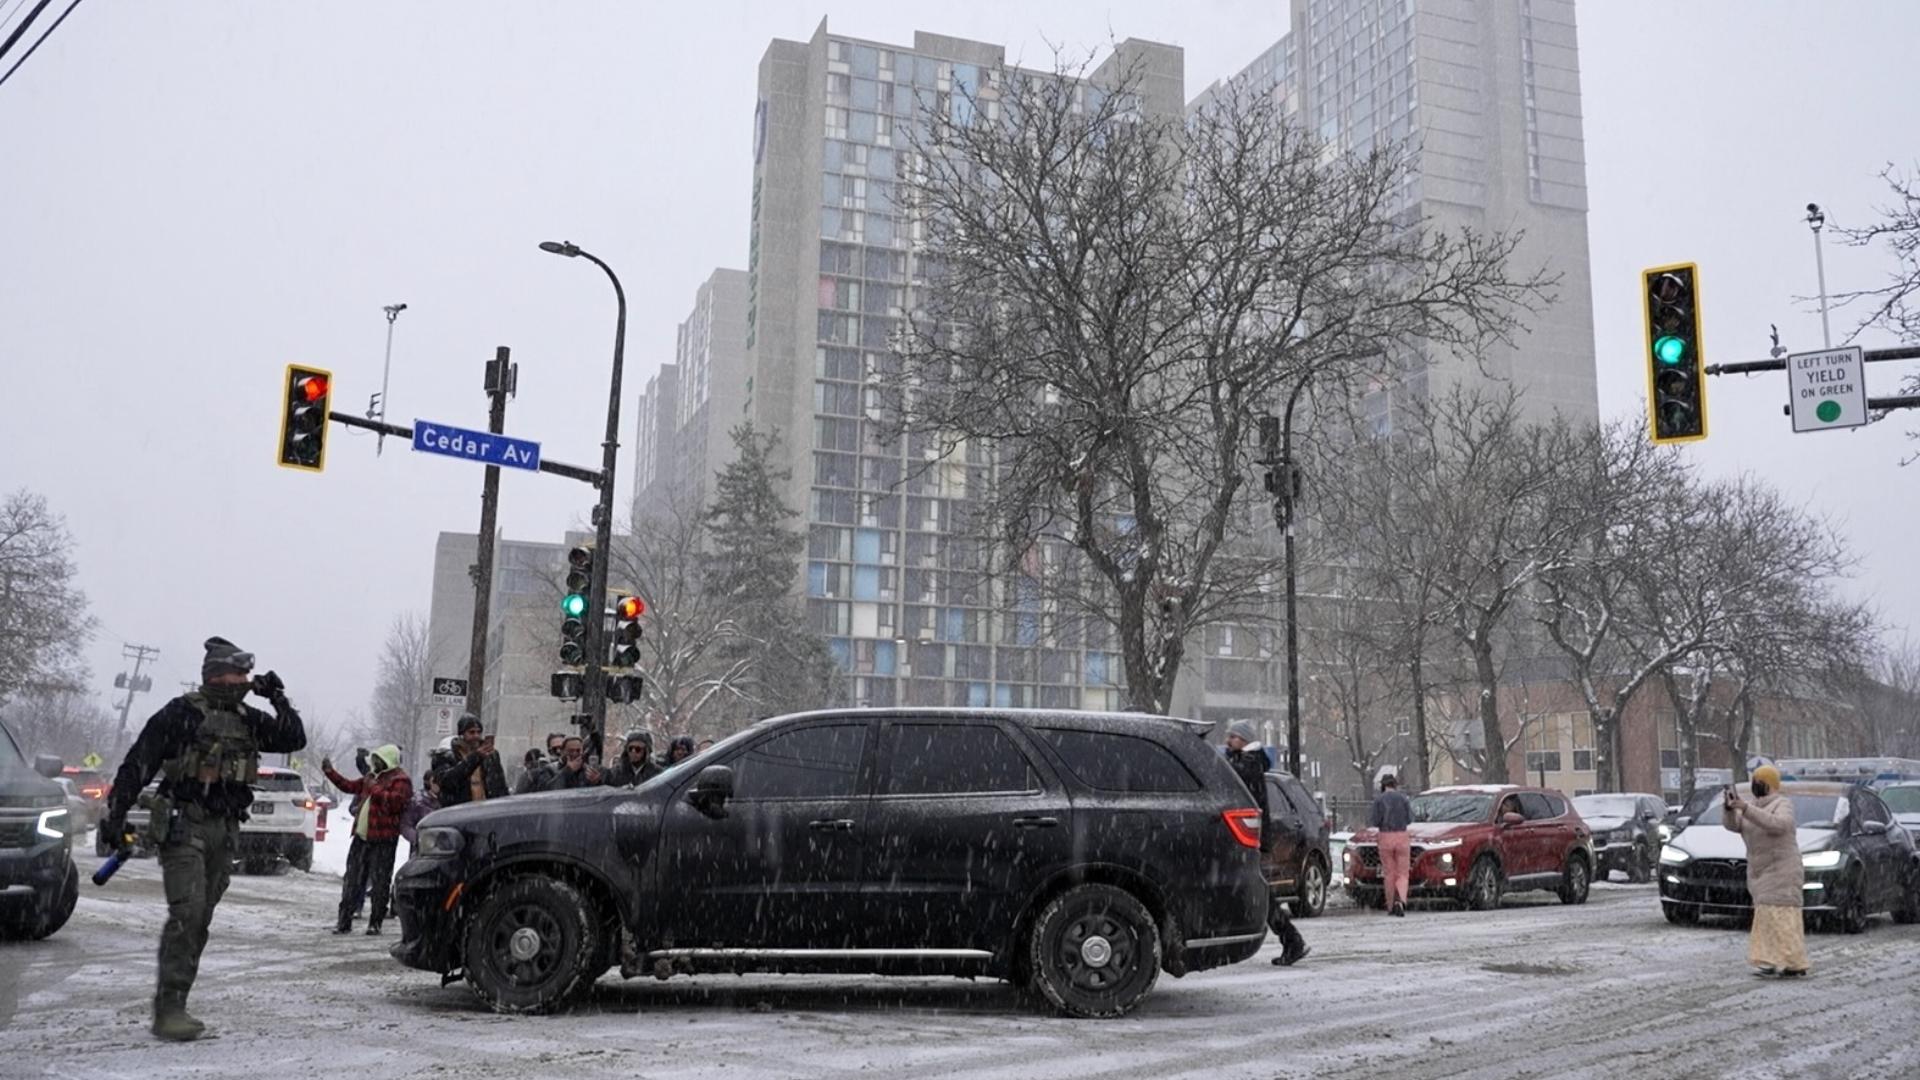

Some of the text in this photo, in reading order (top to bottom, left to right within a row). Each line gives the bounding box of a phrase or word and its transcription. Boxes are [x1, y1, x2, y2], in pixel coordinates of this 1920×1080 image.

[1797, 353, 1852, 369] LEFT TURN
[1806, 368, 1845, 383] YIELD
[1801, 384, 1853, 399] ON GREEN
[422, 428, 531, 464] Cedar Av
